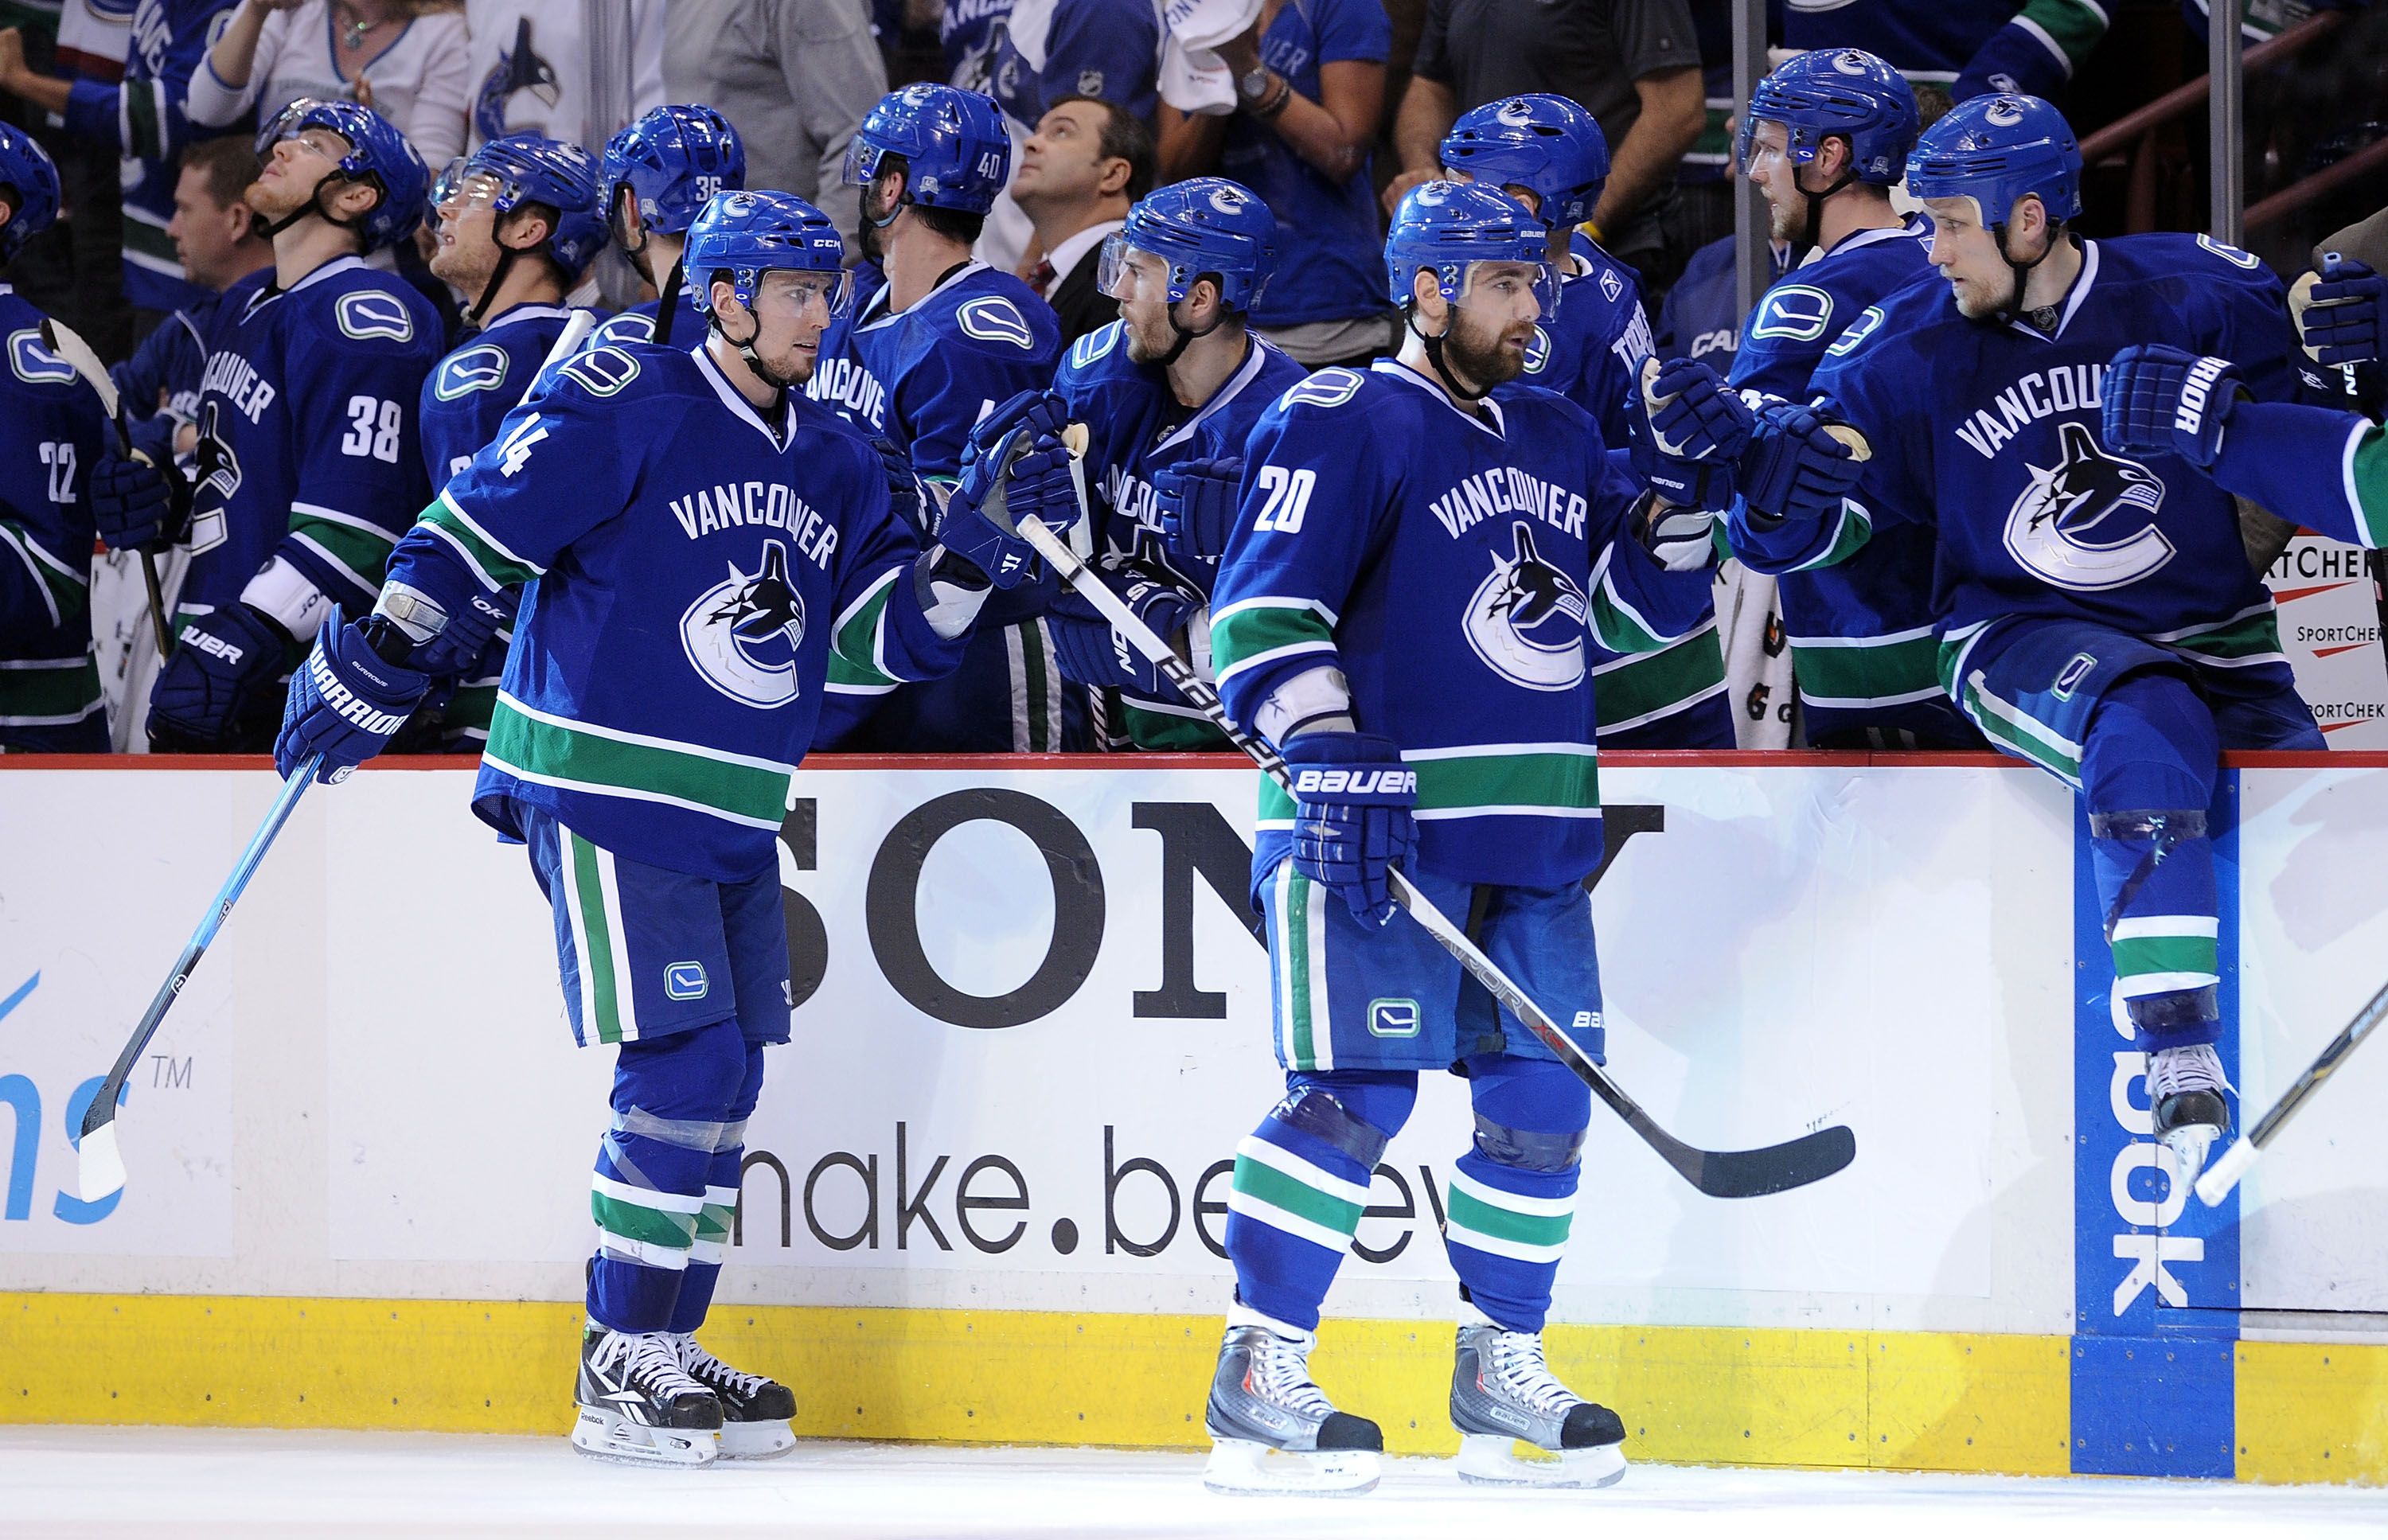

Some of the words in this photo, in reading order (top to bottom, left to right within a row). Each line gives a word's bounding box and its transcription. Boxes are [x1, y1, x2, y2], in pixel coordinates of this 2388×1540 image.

[977, 152, 1001, 180] 40
[695, 175, 722, 202] 36
[341, 395, 401, 464] 38
[1253, 465, 1317, 534] 20
[1429, 466, 1587, 540] VANCOUVER
[669, 481, 838, 571] VANCOUVER
[309, 642, 410, 736] WARRIOR
[351, 660, 388, 688] BURROWS
[1294, 770, 1418, 793] BAUER
[151, 1055, 192, 1089] TM
[580, 1412, 604, 1425] Reebok
